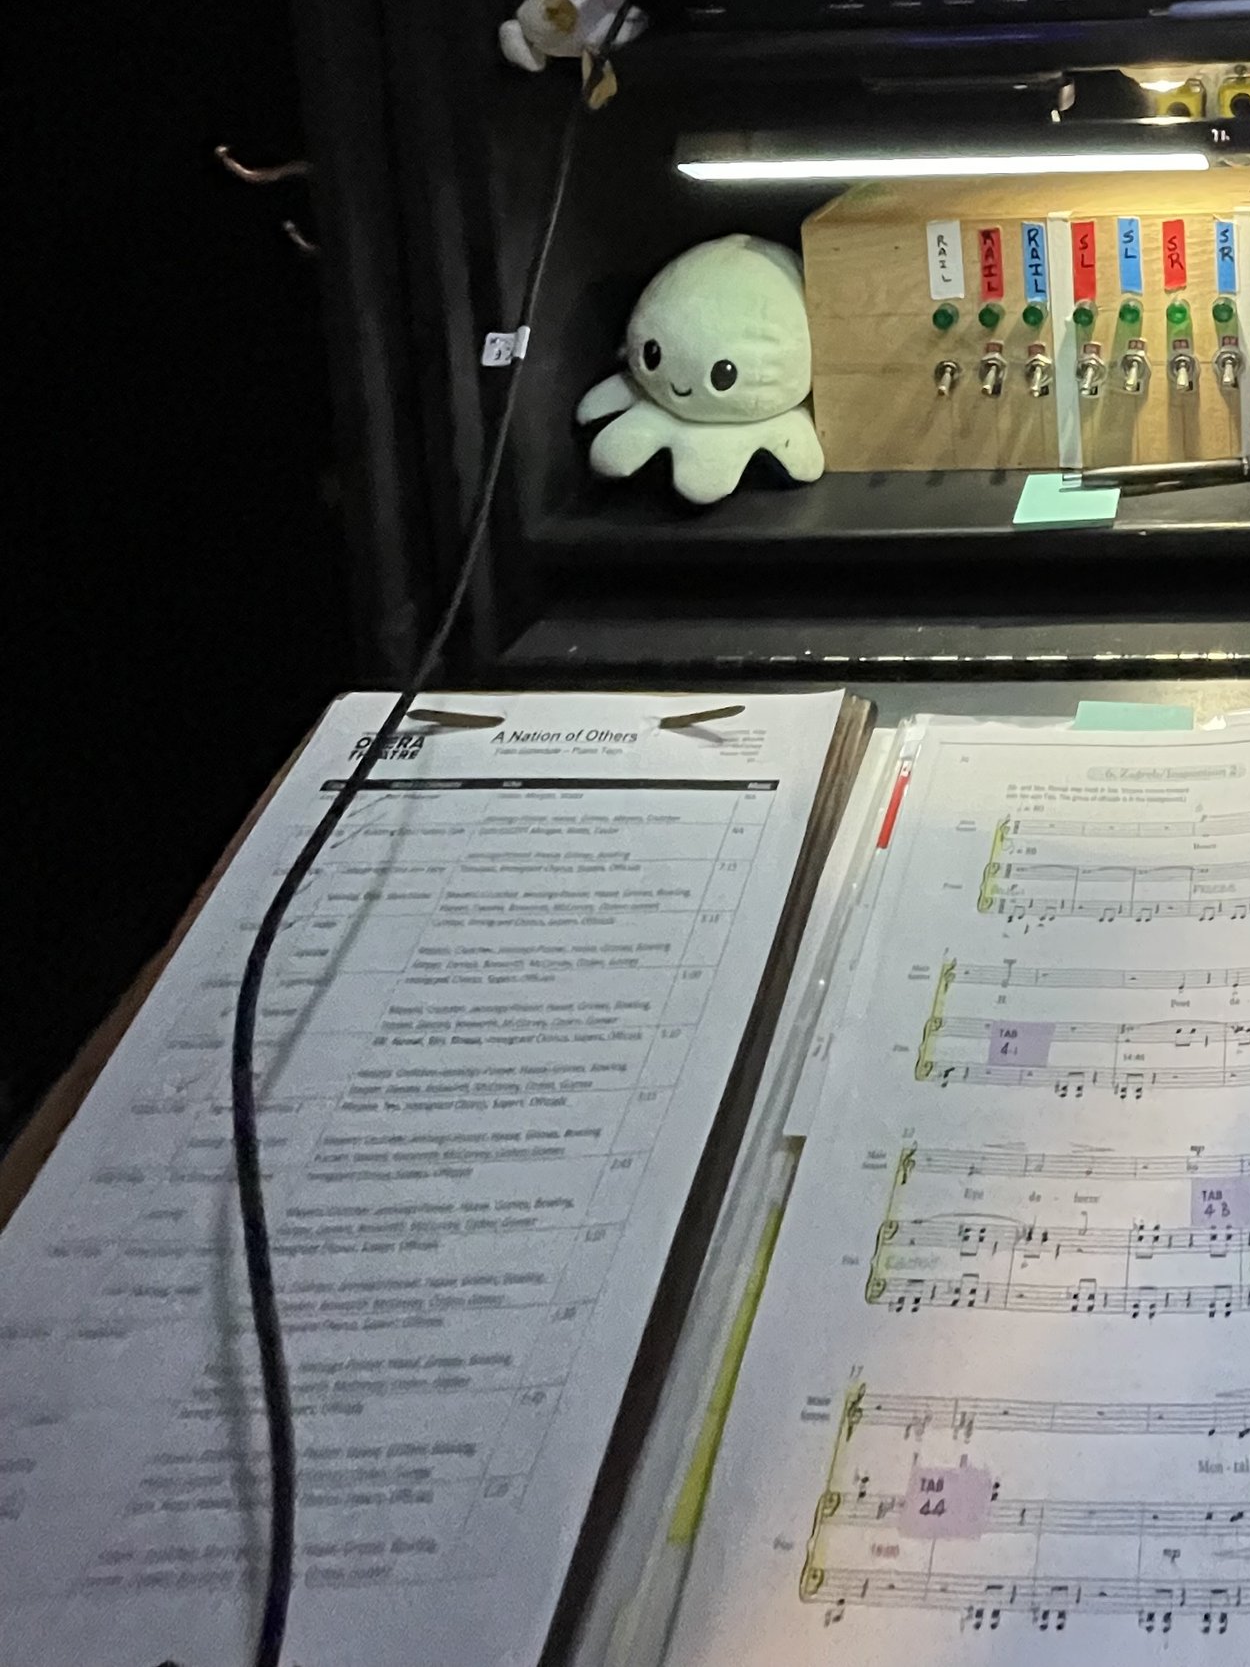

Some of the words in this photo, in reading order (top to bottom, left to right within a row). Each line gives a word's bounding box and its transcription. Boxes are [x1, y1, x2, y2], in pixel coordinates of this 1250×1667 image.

[937, 234, 952, 283] RAIL
[981, 228, 998, 292] RAIL
[1027, 227, 1046, 294] RAIL
[1078, 234, 1094, 268] SL
[1123, 230, 1137, 260] SL
[1167, 236, 1184, 270] SR
[1218, 229, 1234, 263] SR
[355, 736, 425, 749] OERA
[491, 730, 505, 743] A
[509, 730, 560, 743] Nation
[565, 729, 580, 743] of
[585, 729, 639, 743] Others
[348, 748, 421, 761] THATRE
[1202, 1190, 1223, 1202] TAB
[920, 1478, 944, 1493] TAB
